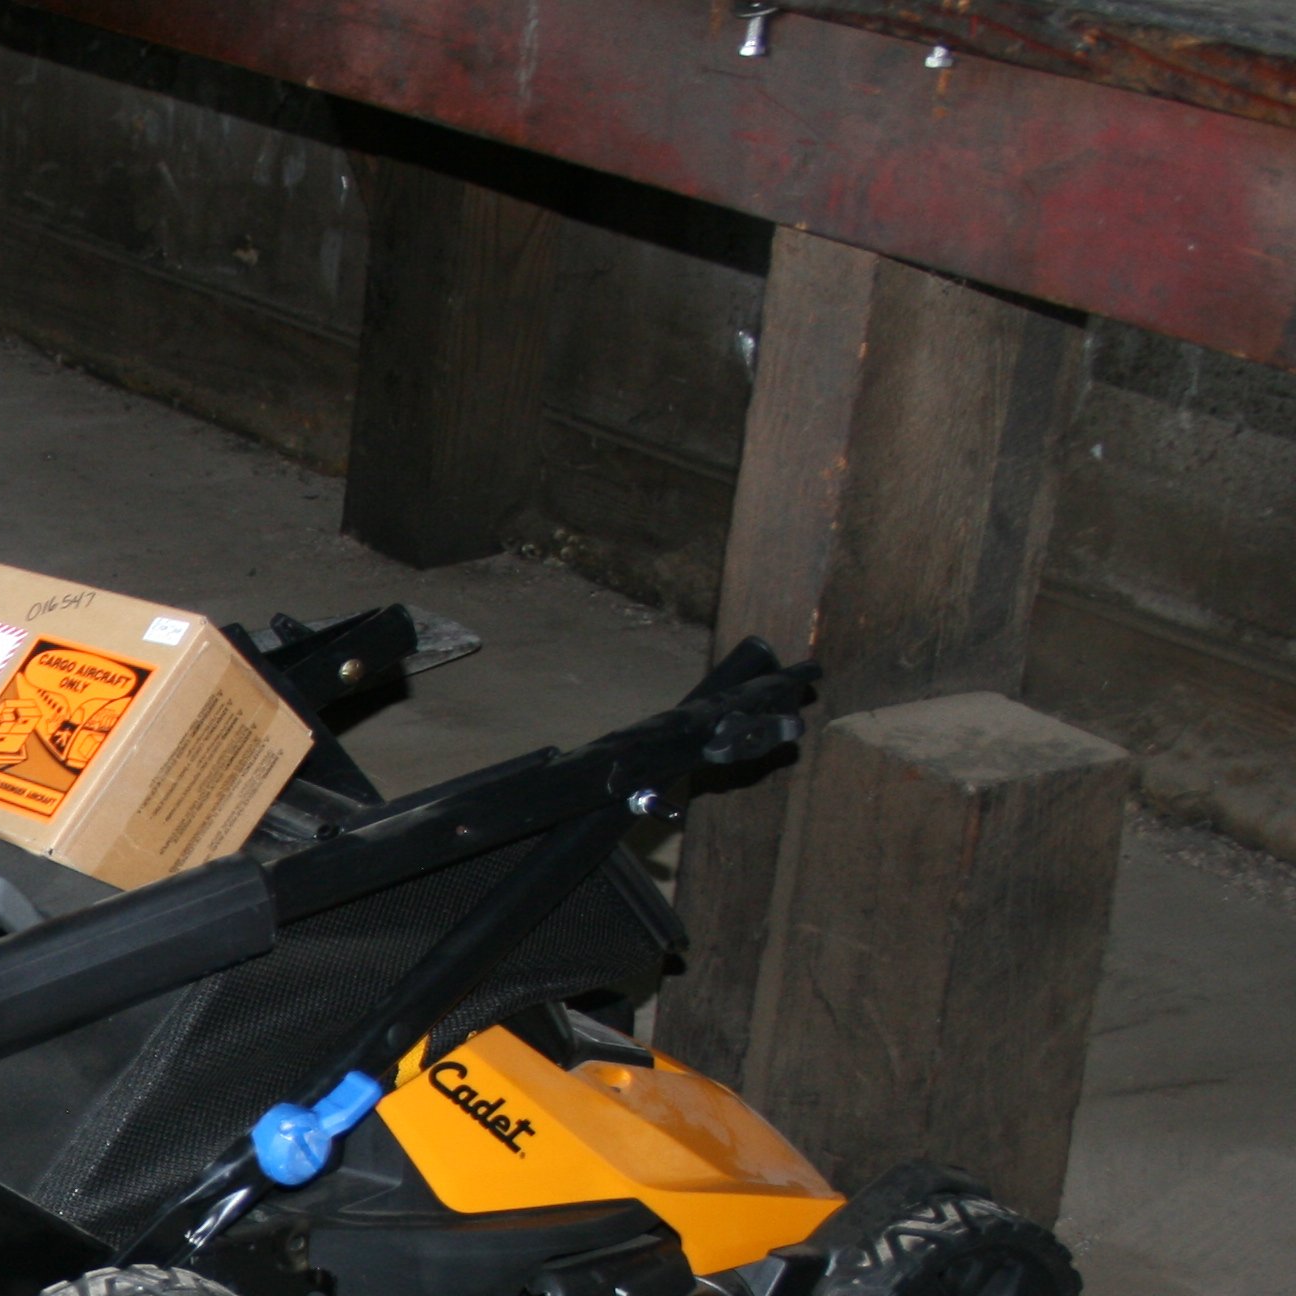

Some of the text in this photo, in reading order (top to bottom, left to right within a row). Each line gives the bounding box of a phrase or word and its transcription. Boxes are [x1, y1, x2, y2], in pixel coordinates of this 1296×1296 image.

[38, 653, 133, 689] CARGO AIRCRAFT
[59, 677, 91, 695] ONLY
[428, 1061, 536, 1155] Cadet
